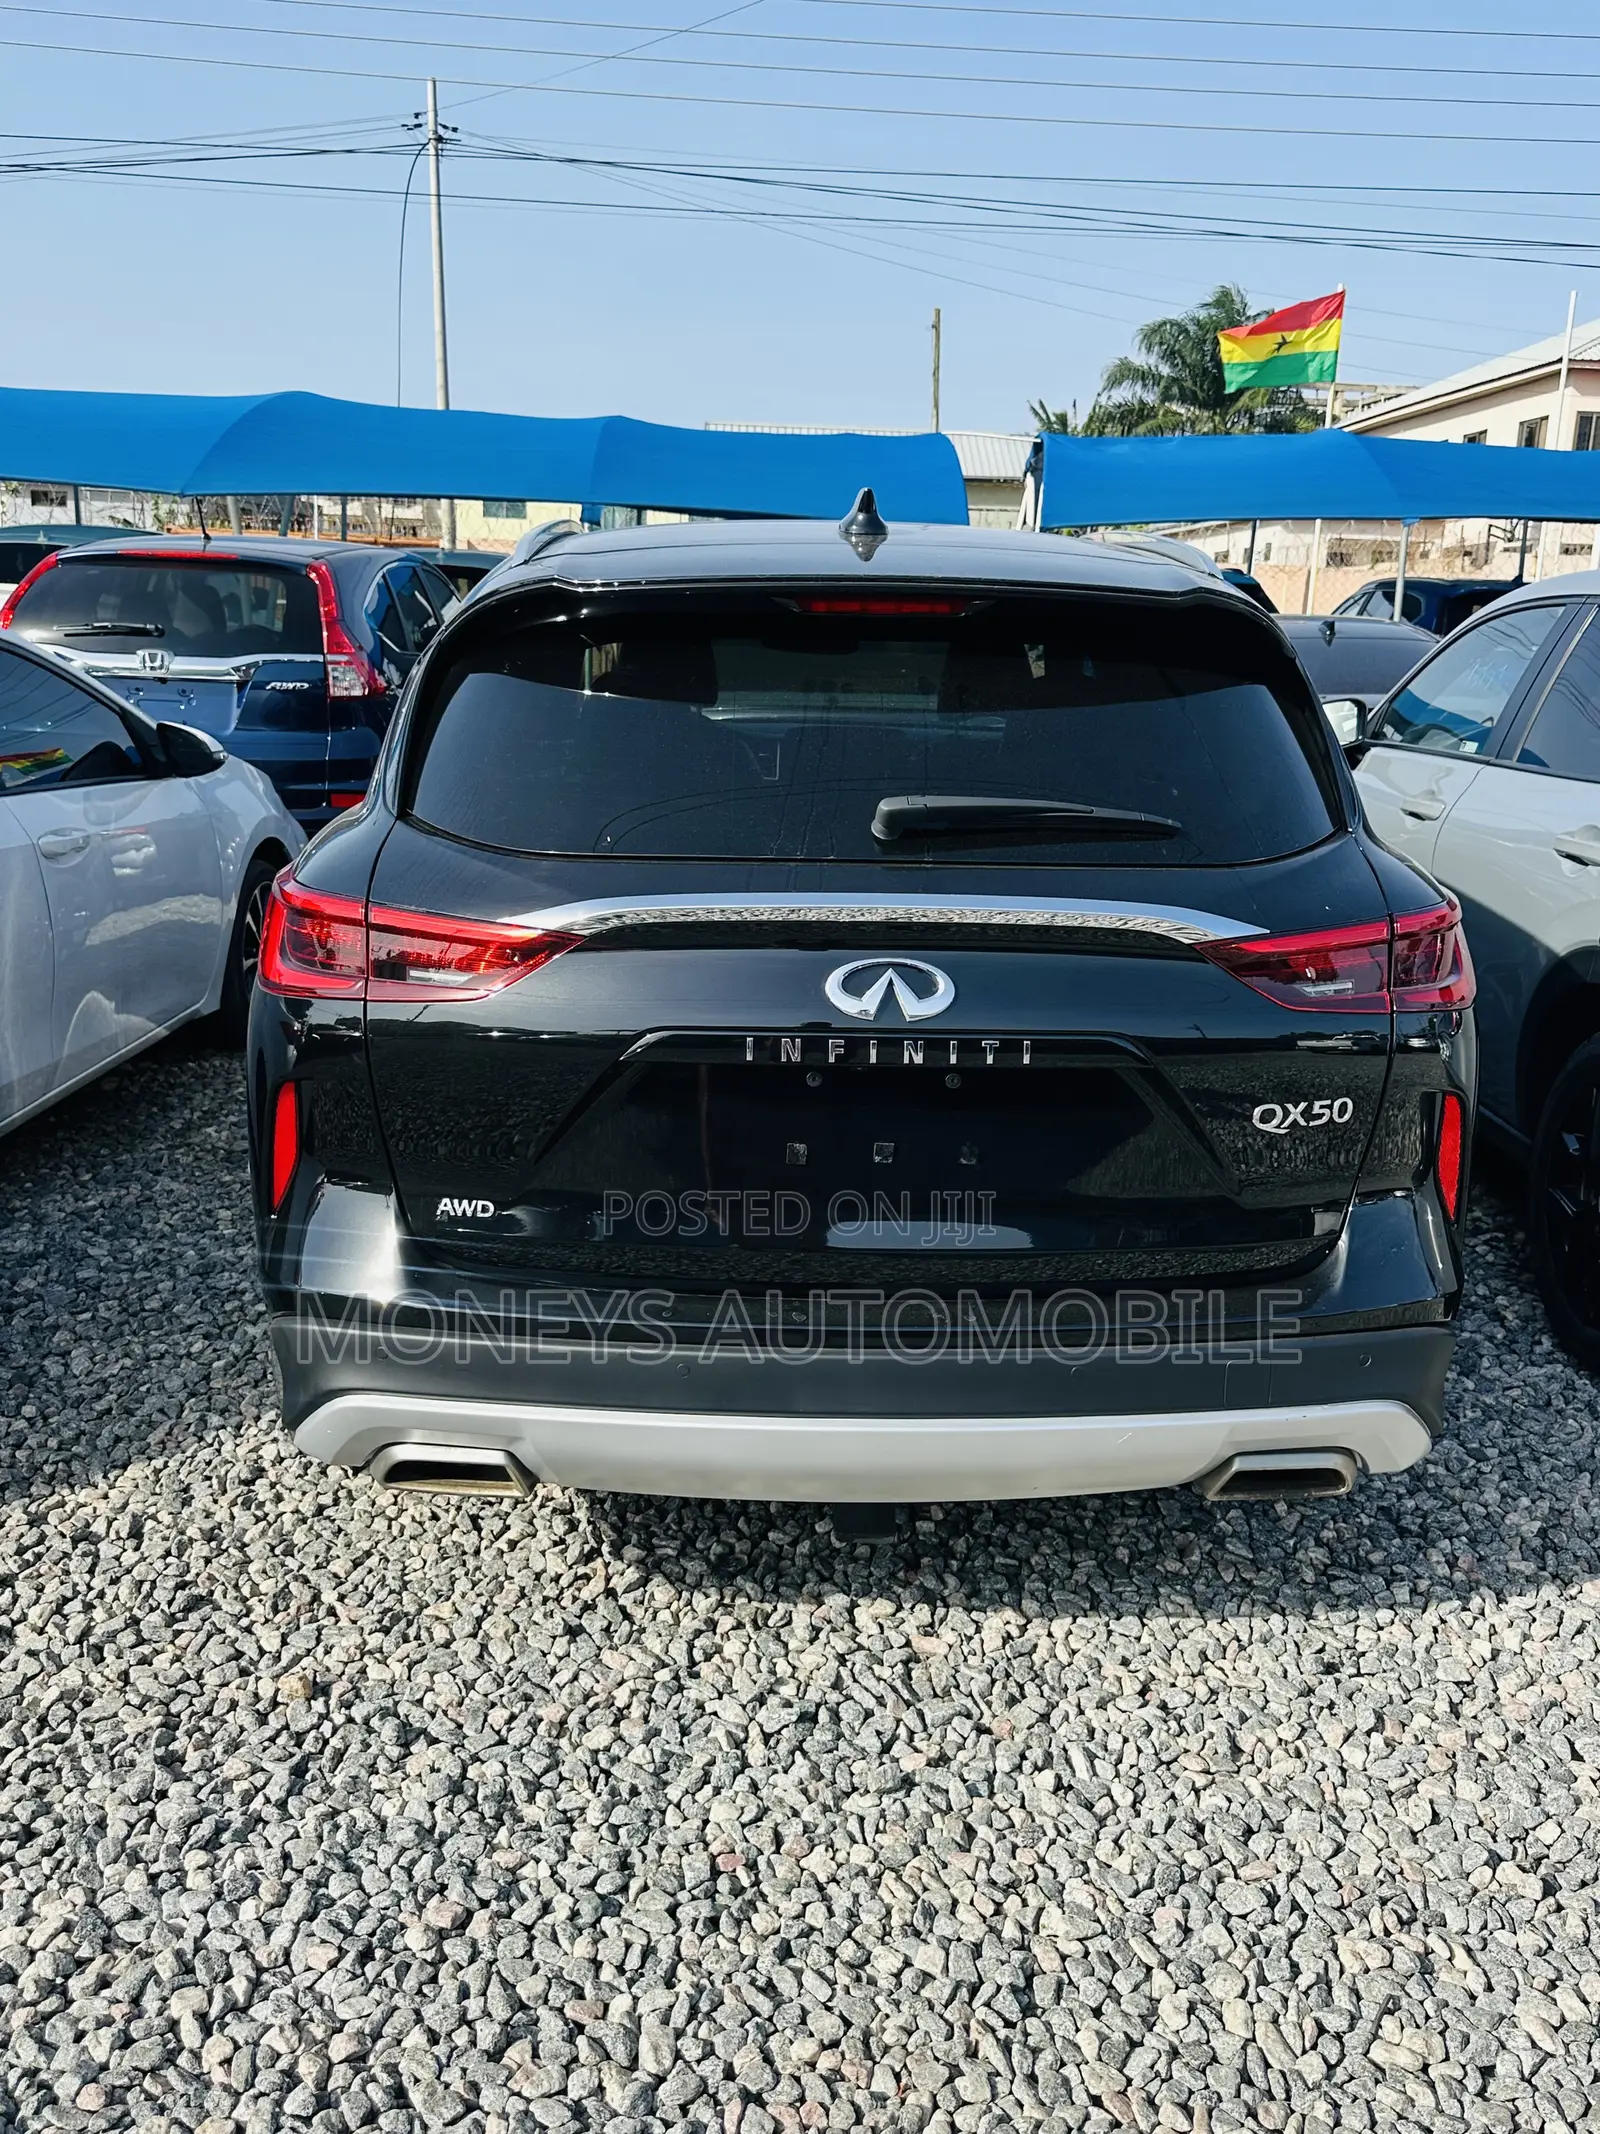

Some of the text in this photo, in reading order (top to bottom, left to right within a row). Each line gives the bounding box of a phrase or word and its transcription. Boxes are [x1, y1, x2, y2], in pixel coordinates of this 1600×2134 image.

[265, 681, 310, 690] AWD
[745, 1037, 1031, 1065] INFINITI
[1252, 1097, 1354, 1134] QX50
[435, 1197, 495, 1218] AWD
